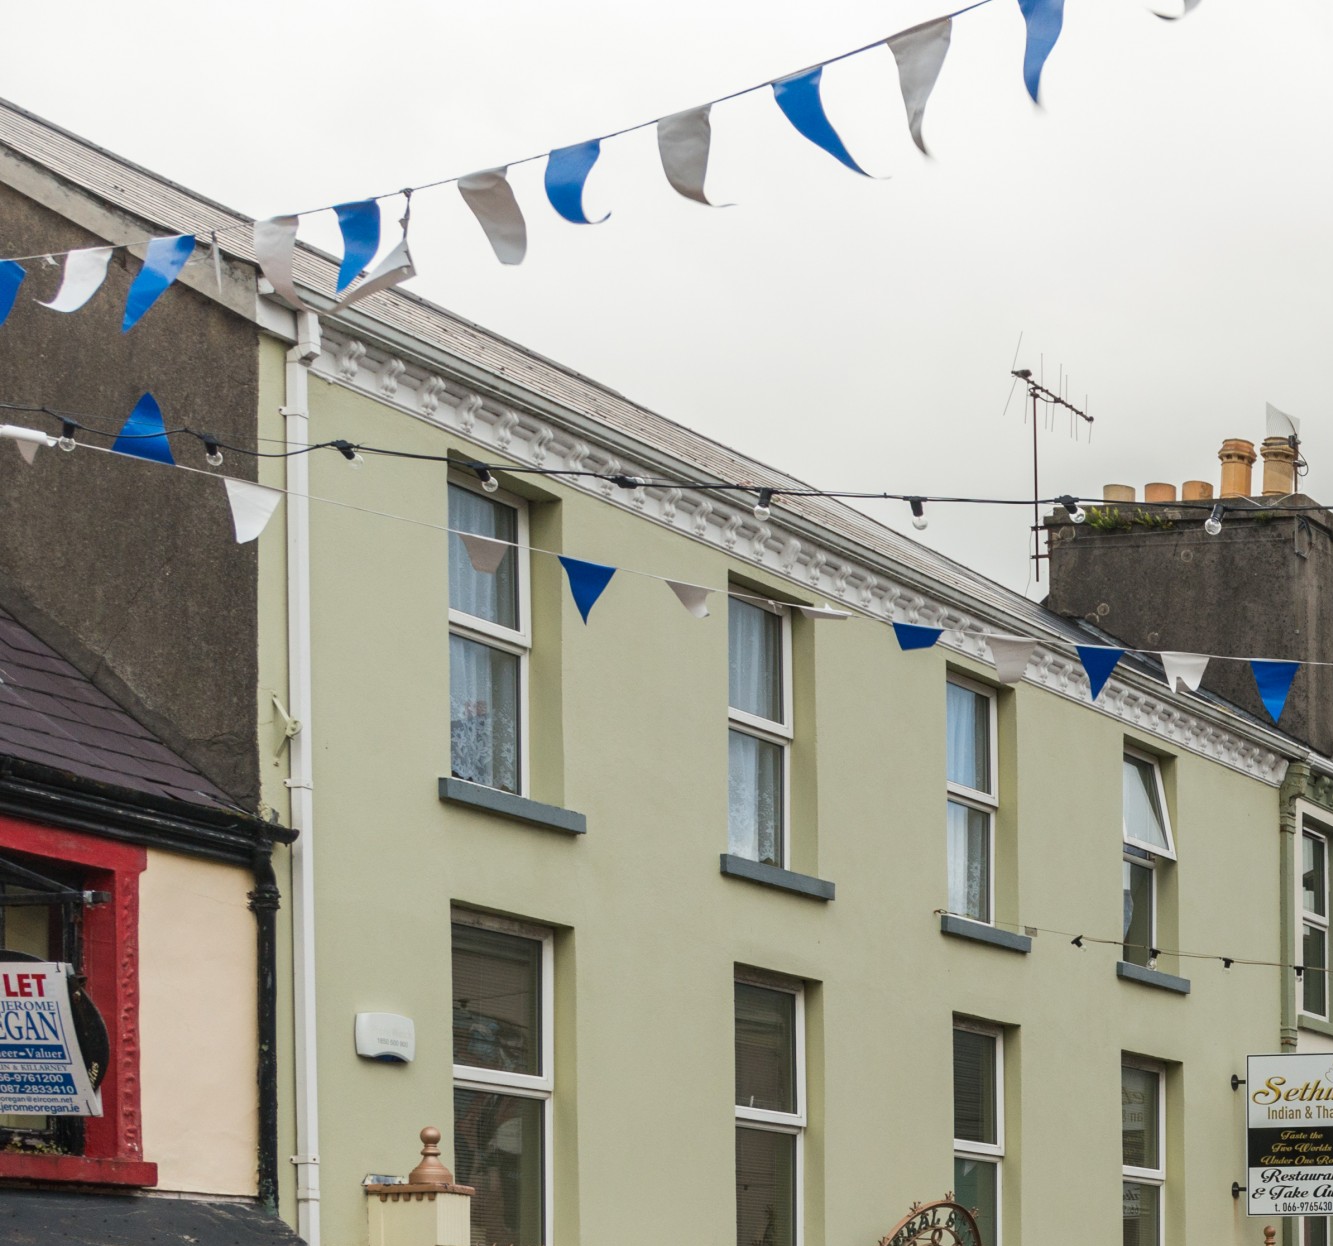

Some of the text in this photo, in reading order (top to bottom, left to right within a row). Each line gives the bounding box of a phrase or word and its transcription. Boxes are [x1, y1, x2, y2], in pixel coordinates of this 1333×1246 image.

[3, 974, 46, 997] LET
[1, 1001, 55, 1012] JEROME
[0, 1011, 60, 1041] GAN
[0, 1048, 62, 1059] eer-Valuer
[21, 1063, 68, 1072] KILLARNEY
[1268, 1106, 1301, 1120] Indian
[1305, 1106, 1313, 1118] &
[1281, 1130, 1324, 1140] Taste the
[1271, 1143, 1332, 1153] Two Worlds
[1260, 1155, 1294, 1165] Under
[1294, 1155, 1314, 1165] One
[1252, 1188, 1266, 1199] &
[1269, 1184, 1309, 1200] Take
[1275, 1202, 1333, 1212] t. 066-9765430
